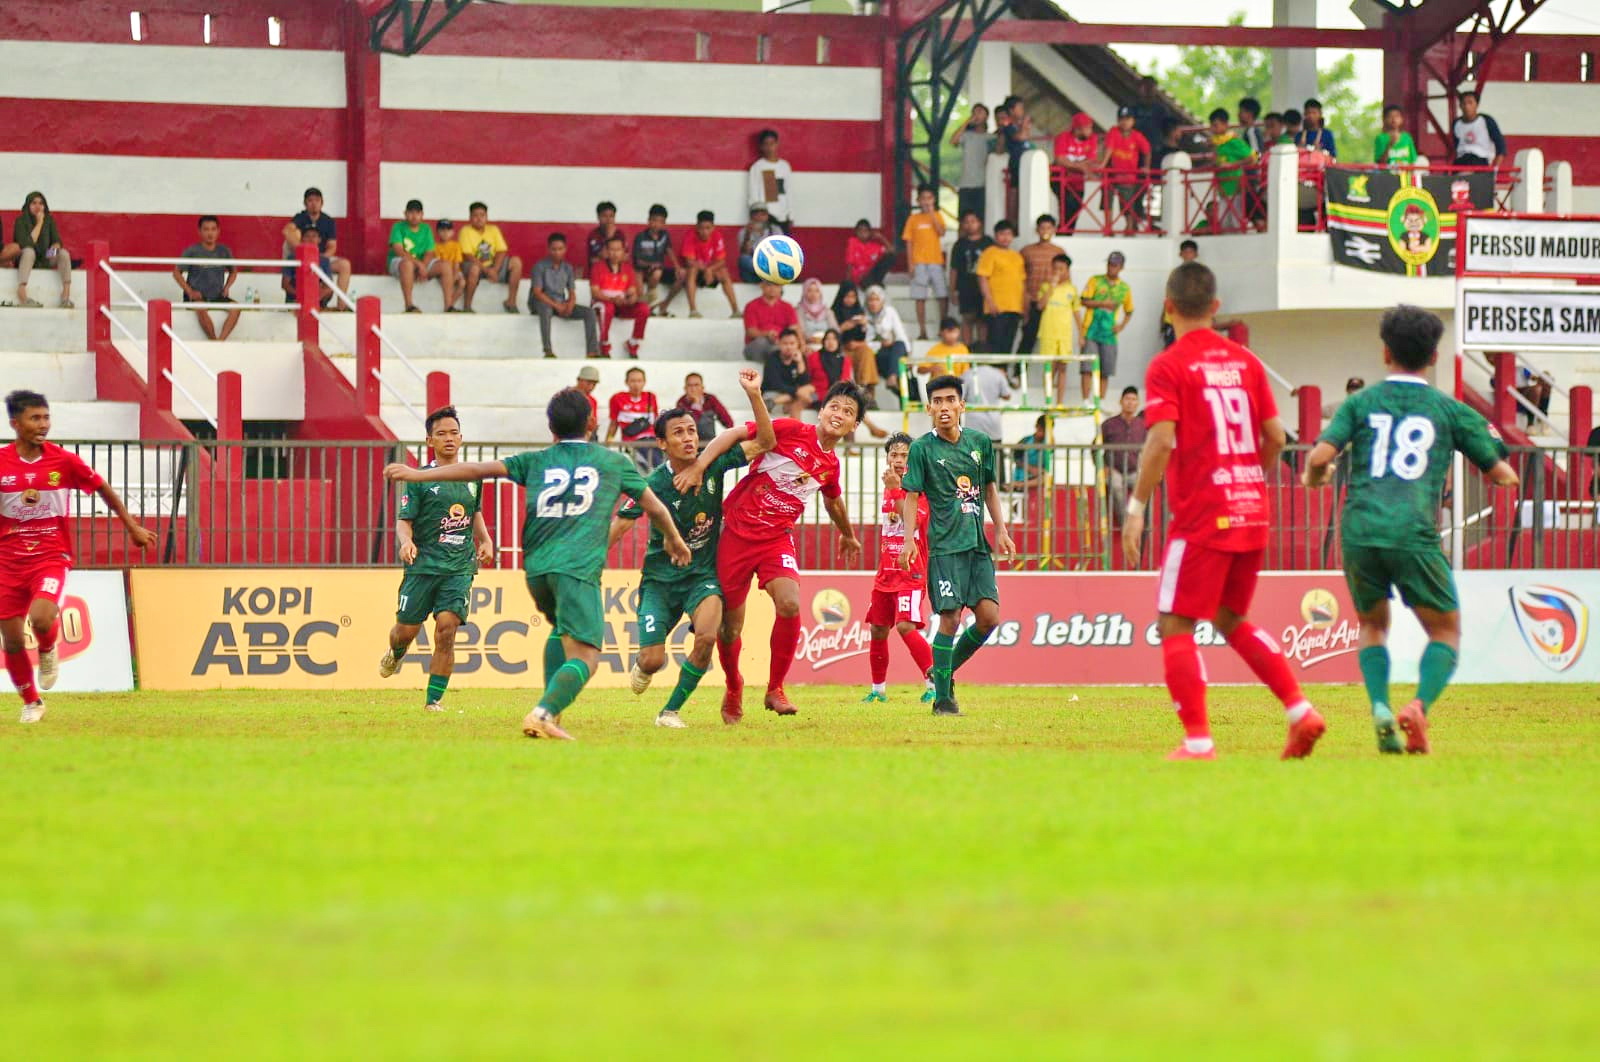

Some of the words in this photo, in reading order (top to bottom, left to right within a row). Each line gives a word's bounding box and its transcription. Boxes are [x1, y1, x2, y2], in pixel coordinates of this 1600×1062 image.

[1470, 234, 1535, 257] PERSSU
[1541, 236, 1600, 259] MADUR
[1467, 305, 1555, 333] PERSESA
[1203, 388, 1255, 455] 19
[1368, 413, 1435, 480] 18
[536, 466, 599, 518] 23
[222, 587, 312, 616] KOPI
[897, 595, 911, 613] 15
[939, 580, 953, 597] 22
[645, 614, 656, 632] 2
[1031, 613, 1132, 646] lebih
[191, 620, 340, 676] ABC
[795, 623, 843, 662] Kapal
[1282, 624, 1332, 661] Kapal
[1330, 619, 1360, 649] Api
